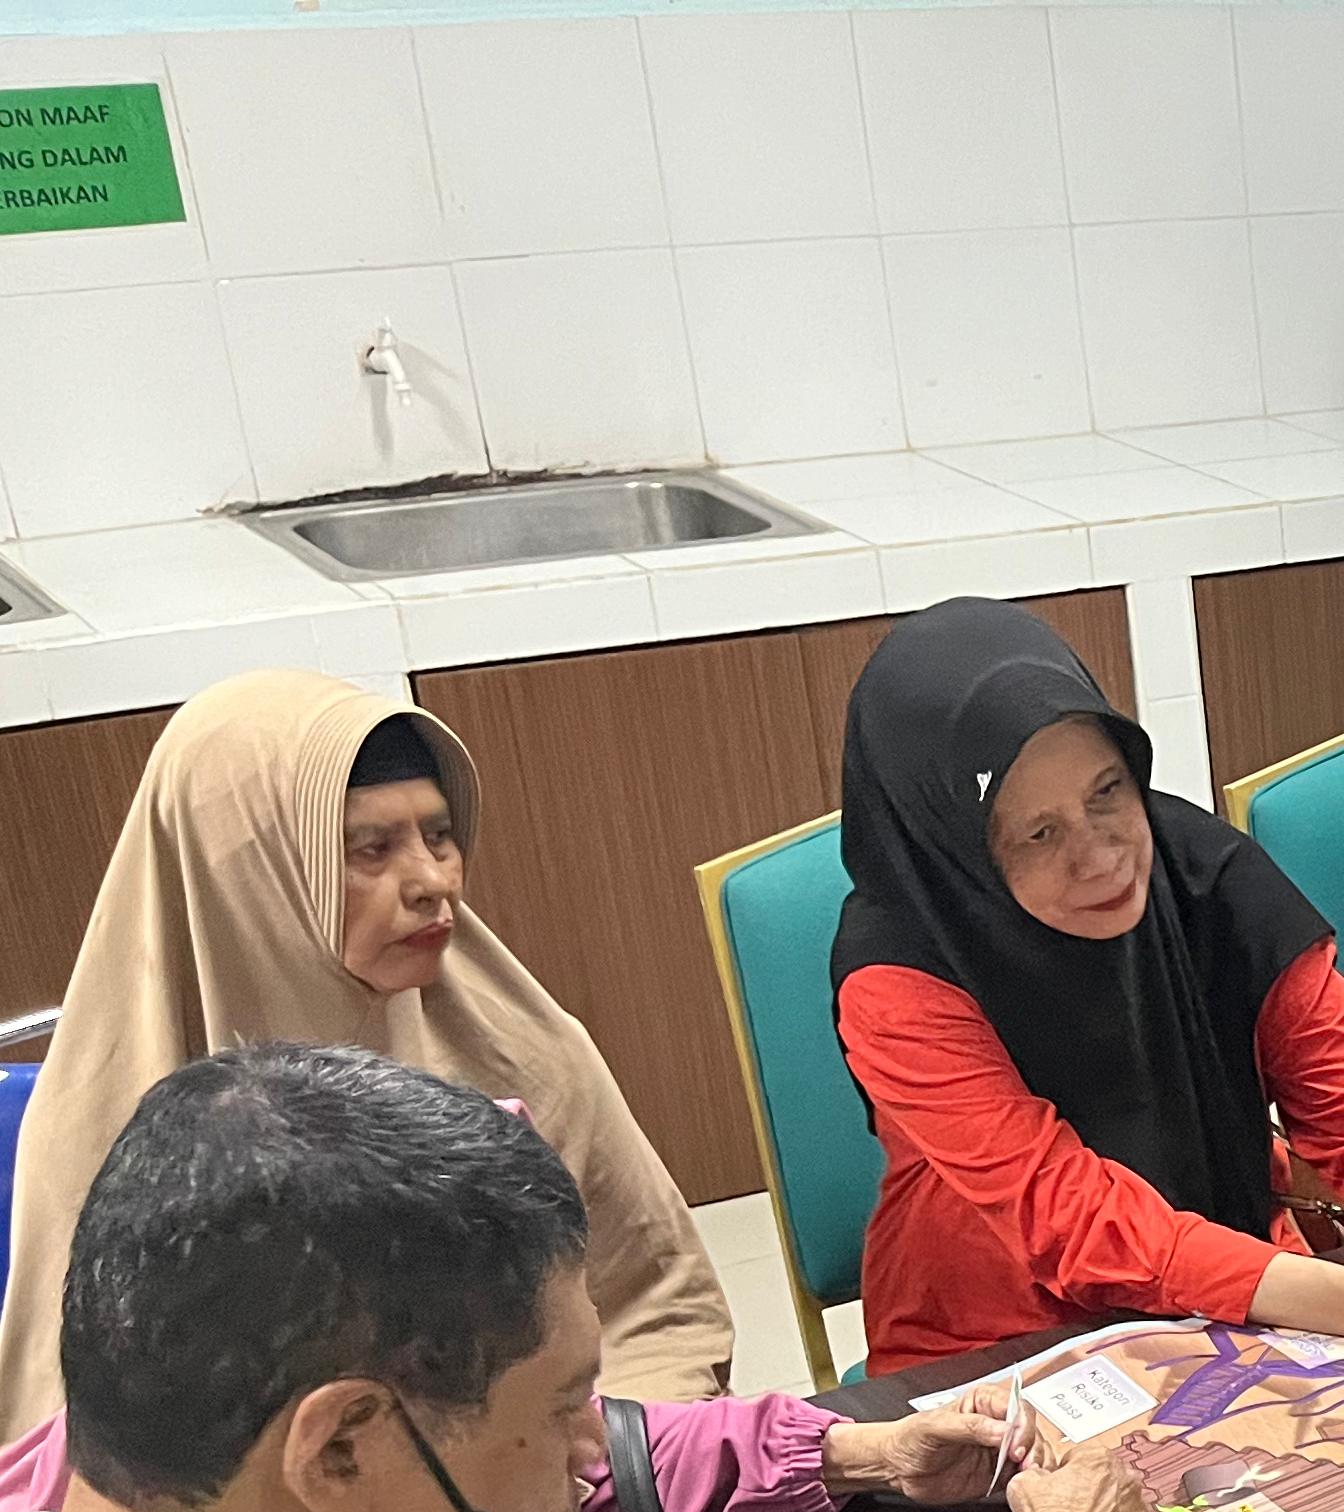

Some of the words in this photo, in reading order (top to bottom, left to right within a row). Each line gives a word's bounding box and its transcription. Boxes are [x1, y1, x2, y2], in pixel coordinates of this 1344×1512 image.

[40, 104, 110, 126] MAAF
[41, 145, 128, 168] DALAM
[0, 184, 109, 209] RBAIKAN
